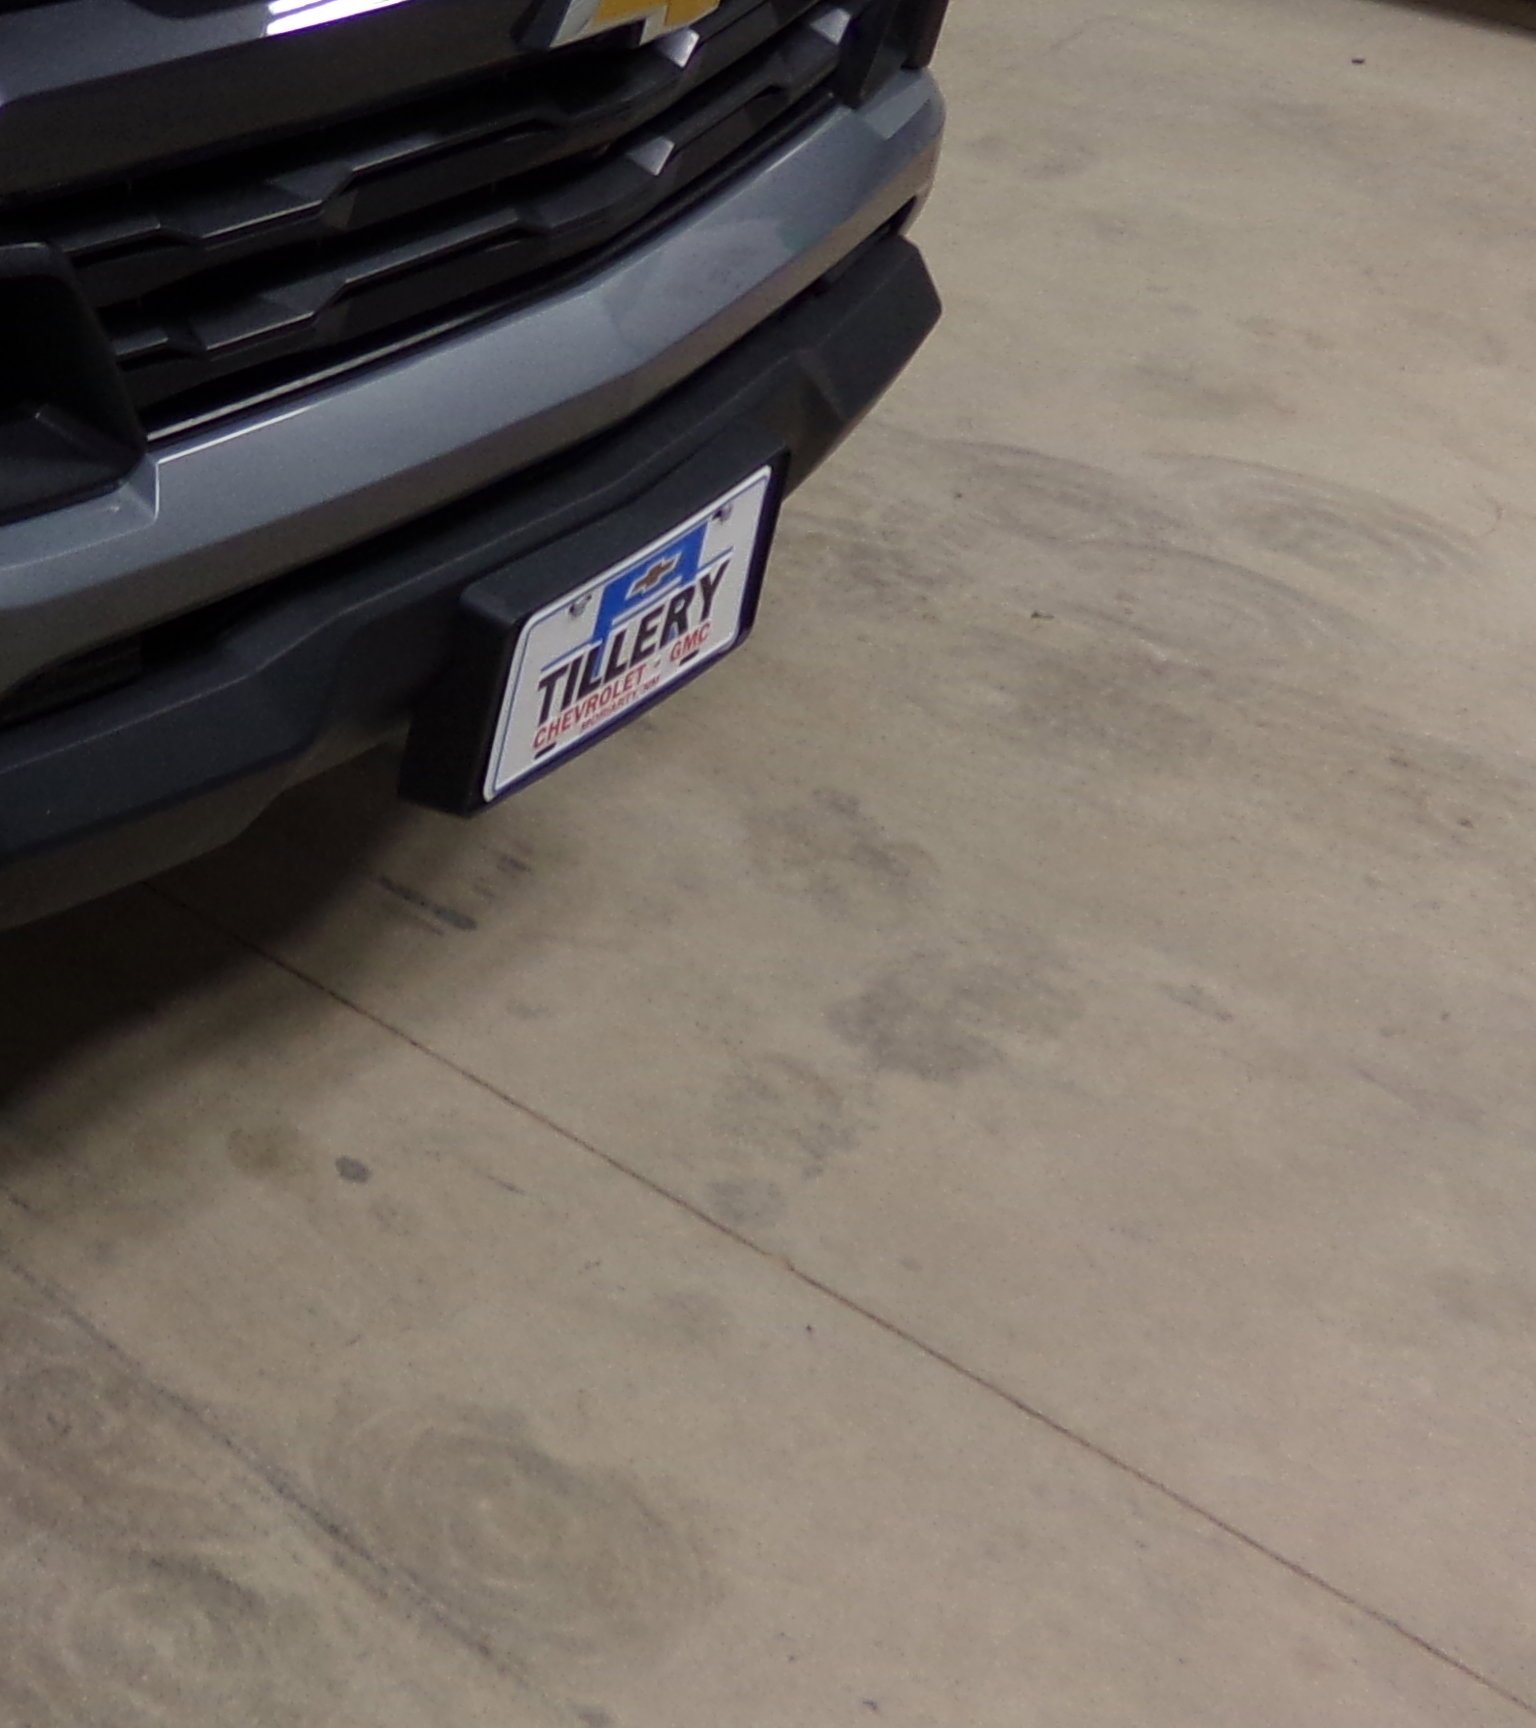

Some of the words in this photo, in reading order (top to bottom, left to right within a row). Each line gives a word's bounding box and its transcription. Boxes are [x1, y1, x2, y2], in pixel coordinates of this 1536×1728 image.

[532, 662, 648, 750] CHEVROLET
[670, 623, 711, 662] GMC
[537, 559, 730, 727] TILLERY
